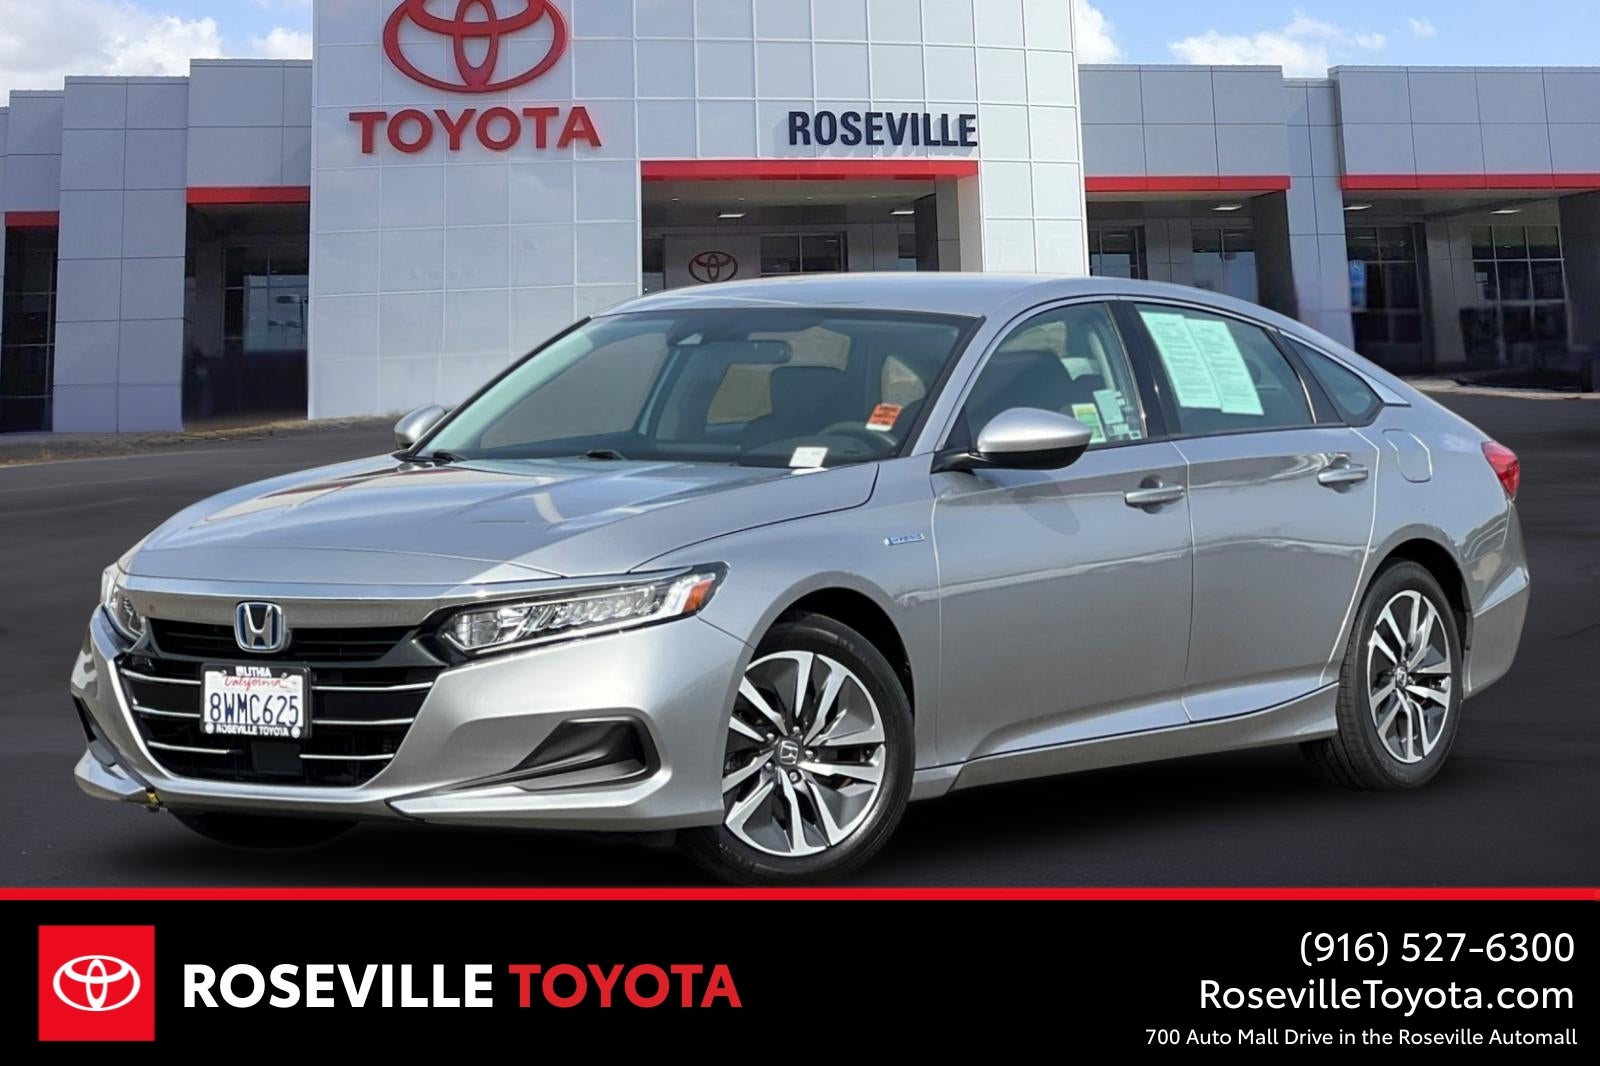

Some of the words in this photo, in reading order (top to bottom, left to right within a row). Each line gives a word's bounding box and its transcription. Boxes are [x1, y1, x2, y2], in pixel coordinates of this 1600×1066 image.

[349, 105, 602, 154] TOYOTA
[788, 110, 978, 147] ROSEVILLE
[224, 677, 286, 691] California
[210, 693, 299, 726] 8WMC625
[216, 724, 258, 735] ROSEVILLE
[259, 726, 289, 737] TOYOTA
